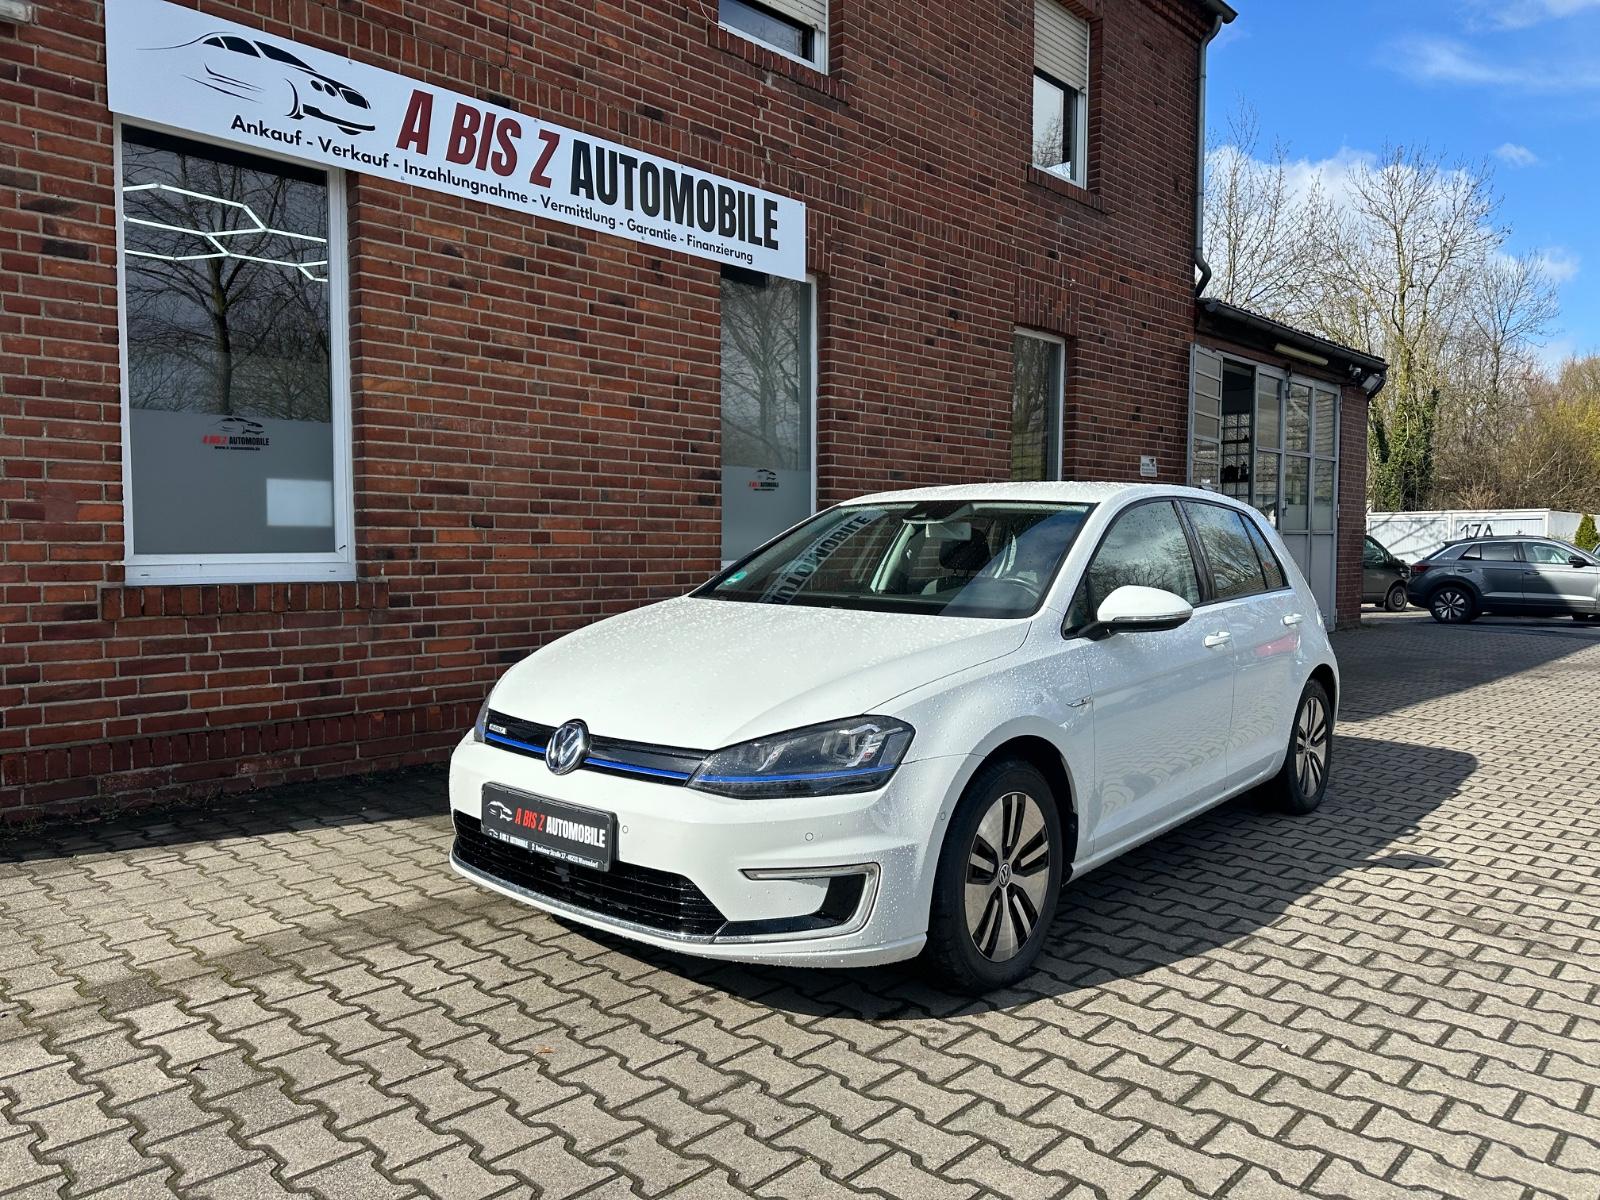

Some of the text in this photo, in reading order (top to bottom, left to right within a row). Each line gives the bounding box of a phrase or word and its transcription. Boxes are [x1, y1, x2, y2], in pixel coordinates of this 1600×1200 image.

[231, 114, 302, 146] Ankauf
[317, 135, 389, 169] Verkauf
[404, 158, 529, 204] Inzahlungnahme
[540, 193, 616, 230] Vermittlung
[627, 217, 678, 243] Garantie
[686, 233, 754, 265] Finanzierung
[396, 89, 779, 251] A BIS Z AUTOMOBILE
[229, 436, 270, 446] AUTOMOBILE
[1460, 524, 1494, 539] 17A
[515, 808, 606, 848] A BIS Z AUTOMOBILE
